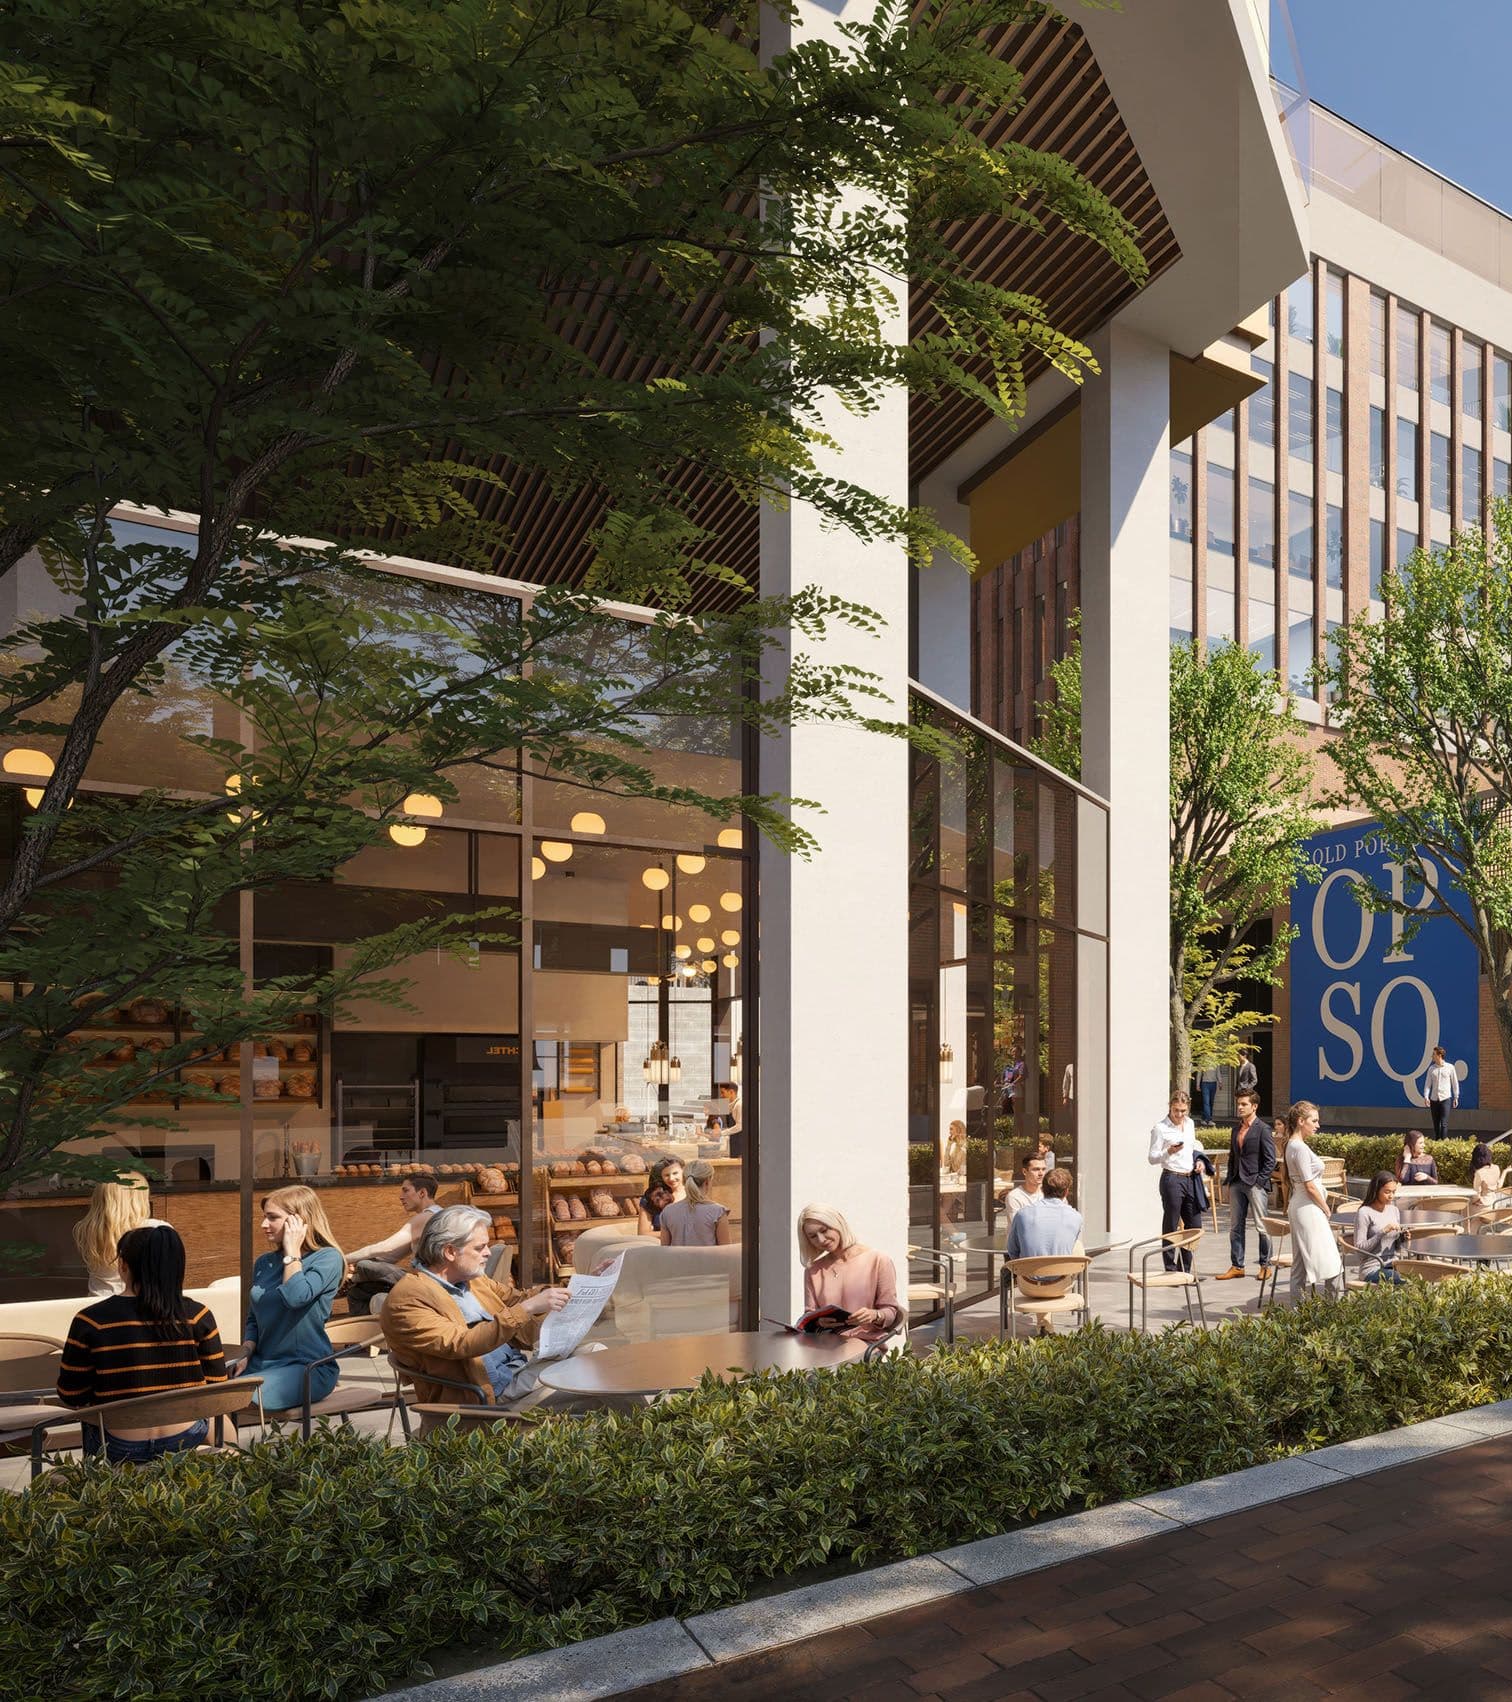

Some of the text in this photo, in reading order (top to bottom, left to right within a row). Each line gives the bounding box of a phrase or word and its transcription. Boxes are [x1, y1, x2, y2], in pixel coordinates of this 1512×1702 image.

[1312, 843, 1347, 865] OLD
[1311, 857, 1438, 970] OP
[1318, 975, 1468, 1108] SQ.
